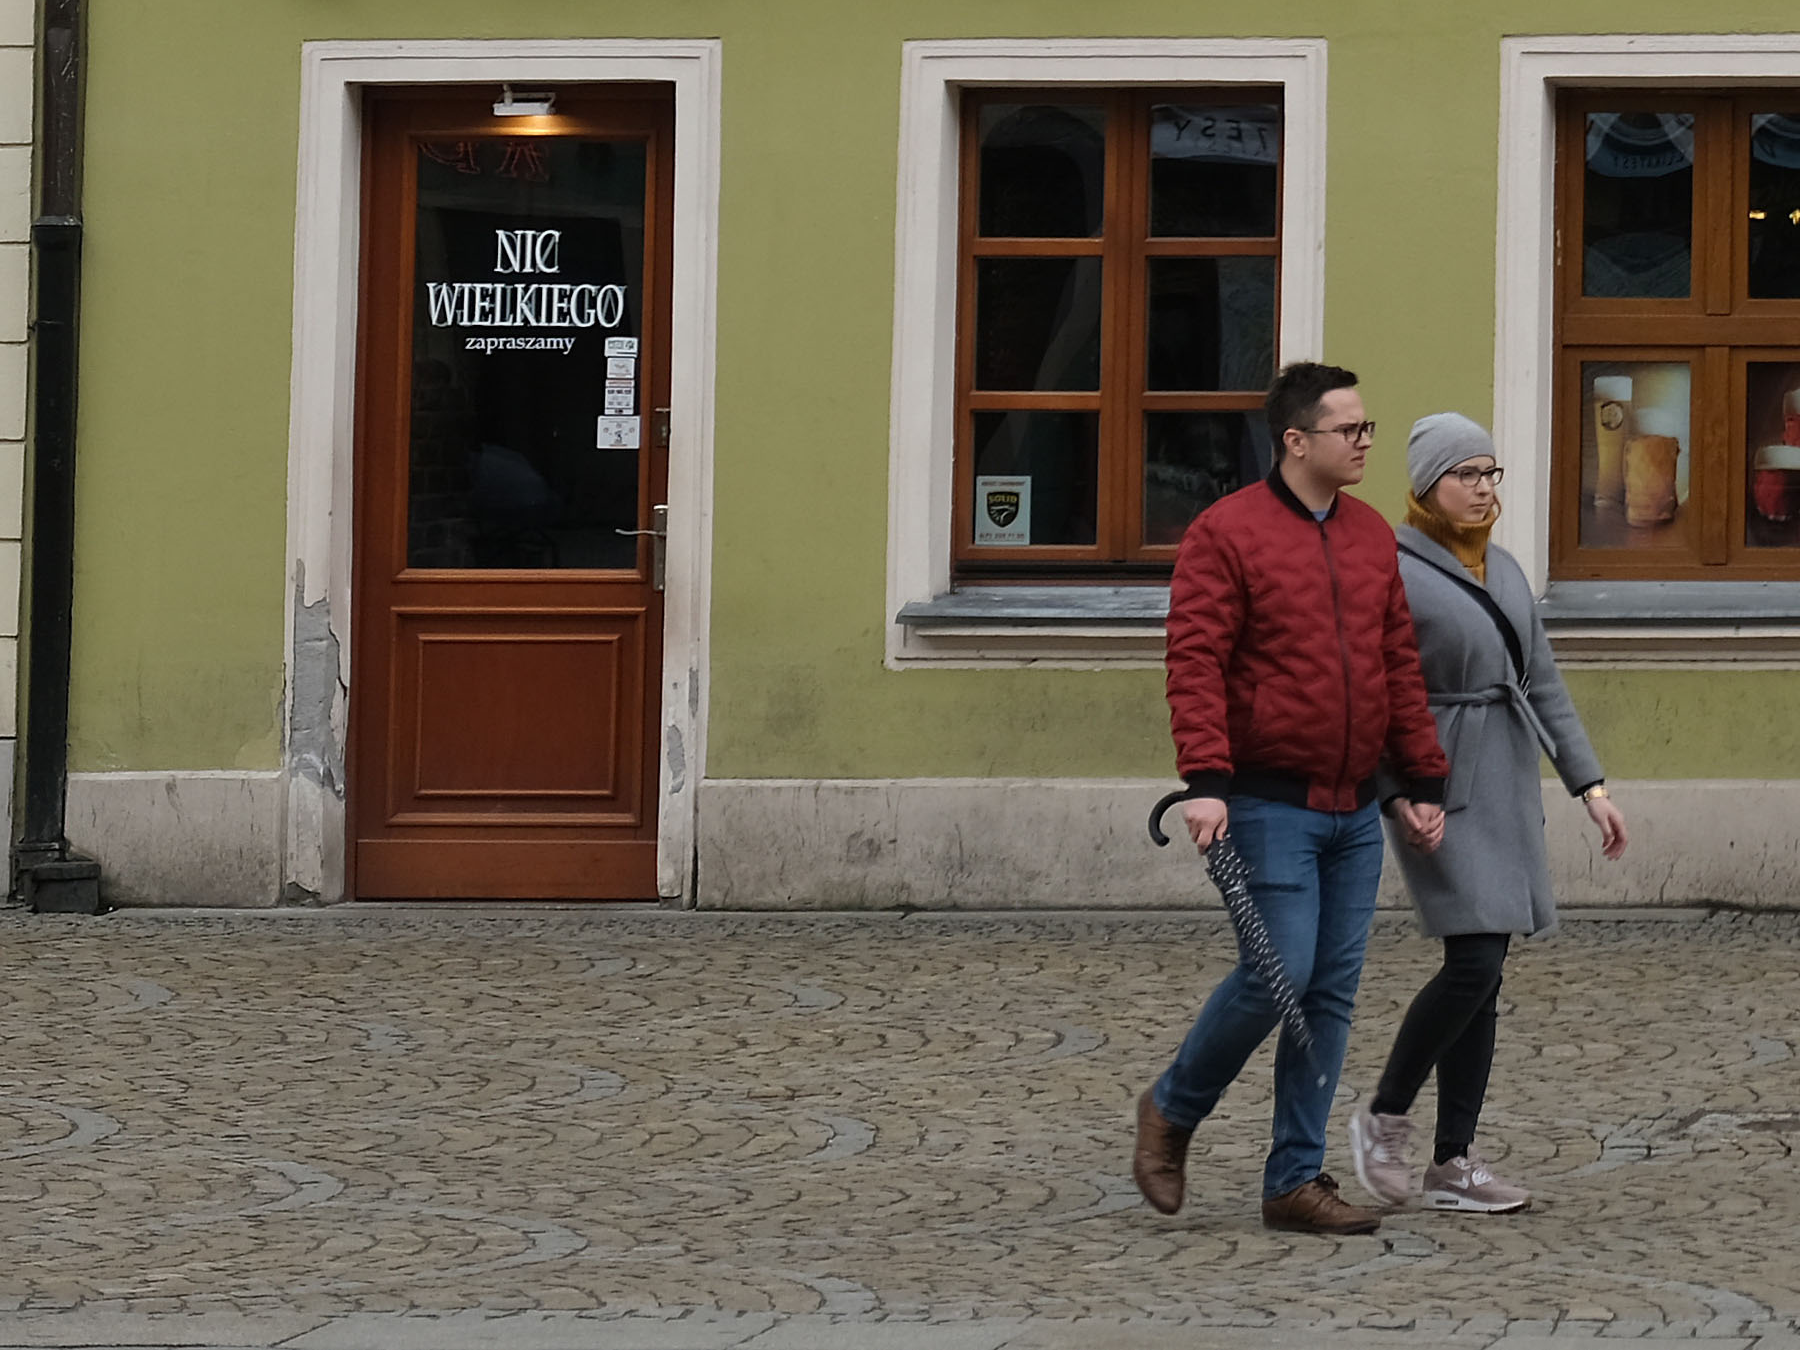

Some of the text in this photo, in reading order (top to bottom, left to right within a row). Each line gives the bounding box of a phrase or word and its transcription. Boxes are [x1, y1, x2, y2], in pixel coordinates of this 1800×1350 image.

[494, 229, 562, 274] NIC
[426, 282, 626, 328] WIELKIEGO
[464, 335, 577, 355] zapraszamy
